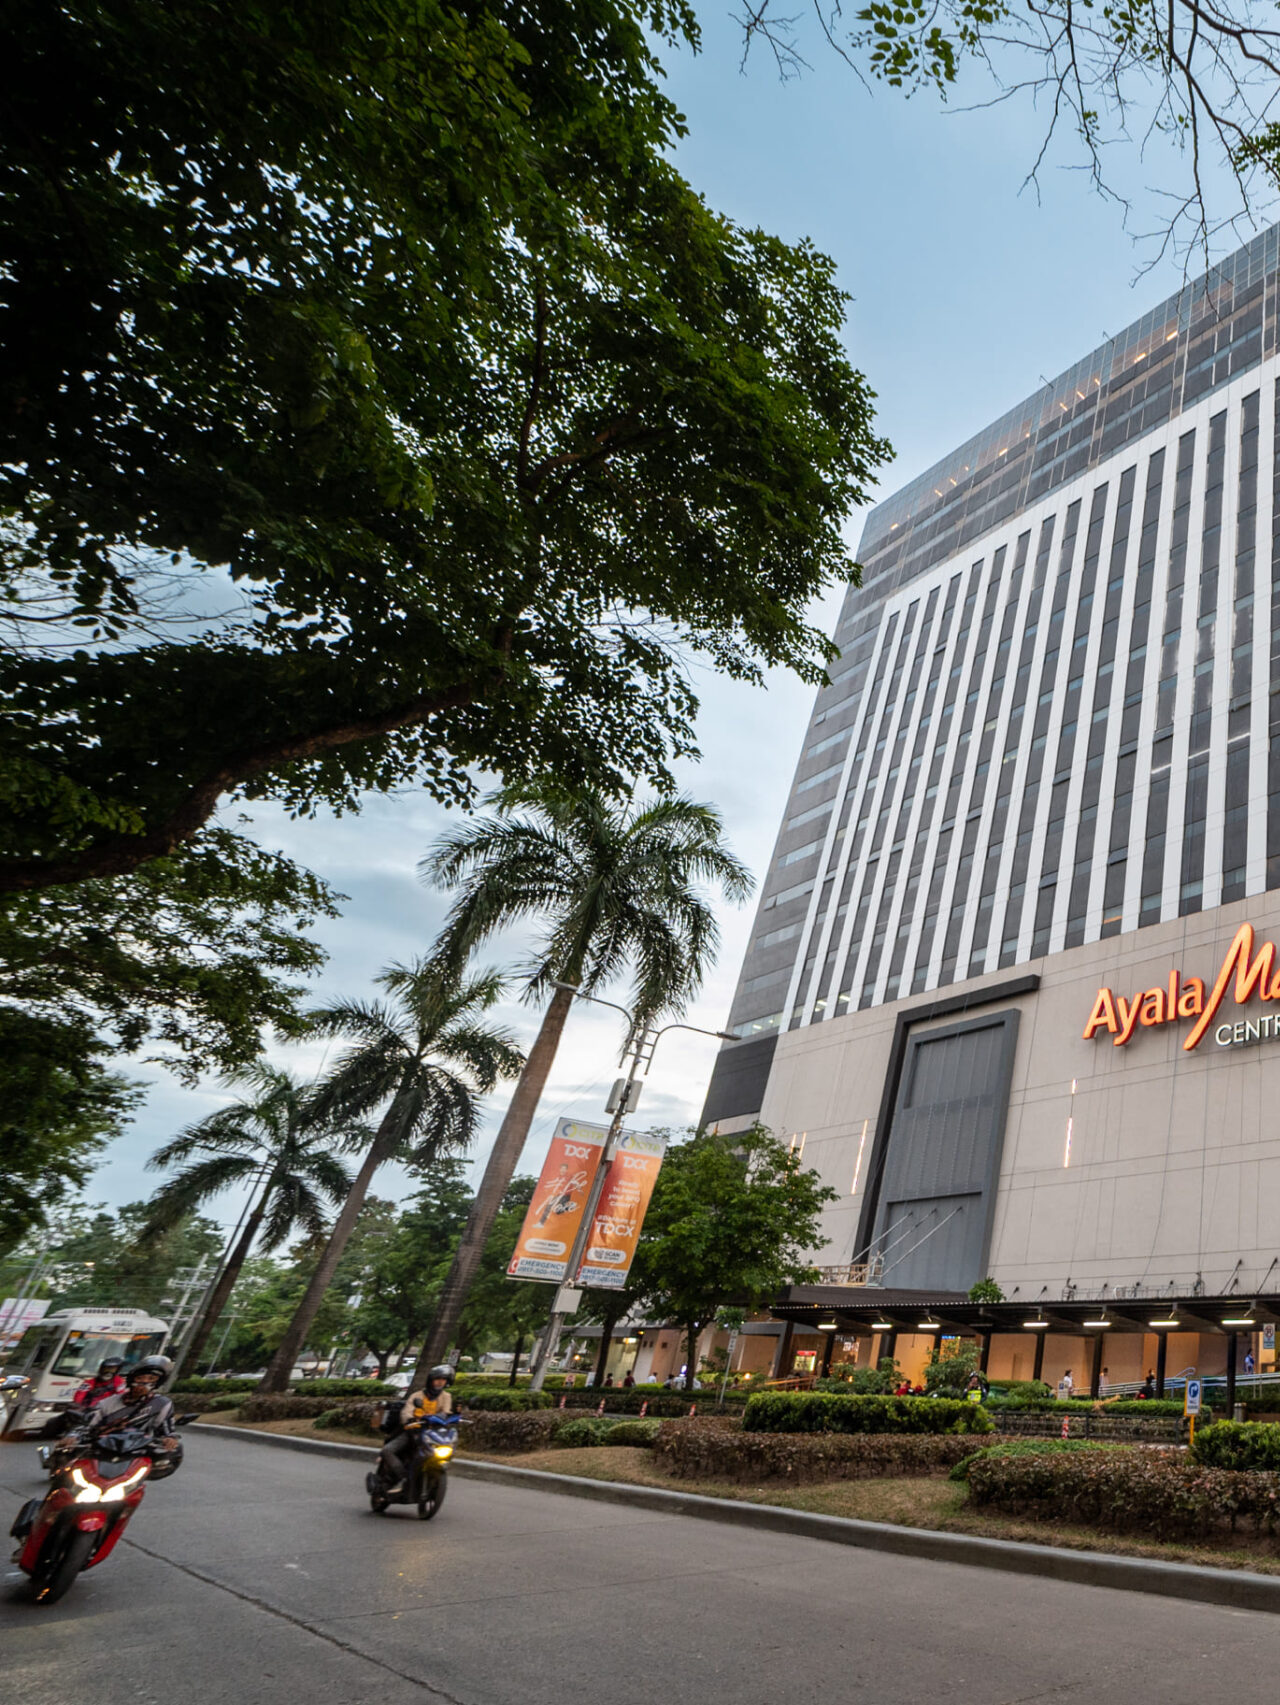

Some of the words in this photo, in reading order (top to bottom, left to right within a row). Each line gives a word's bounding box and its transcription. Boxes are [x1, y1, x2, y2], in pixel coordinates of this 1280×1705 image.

[1082, 970, 1206, 1046] Ayala
[595, 1222, 635, 1238] TDCX
[520, 1259, 565, 1270] EMERGENCY
[582, 1267, 627, 1279] EMERGENCY
